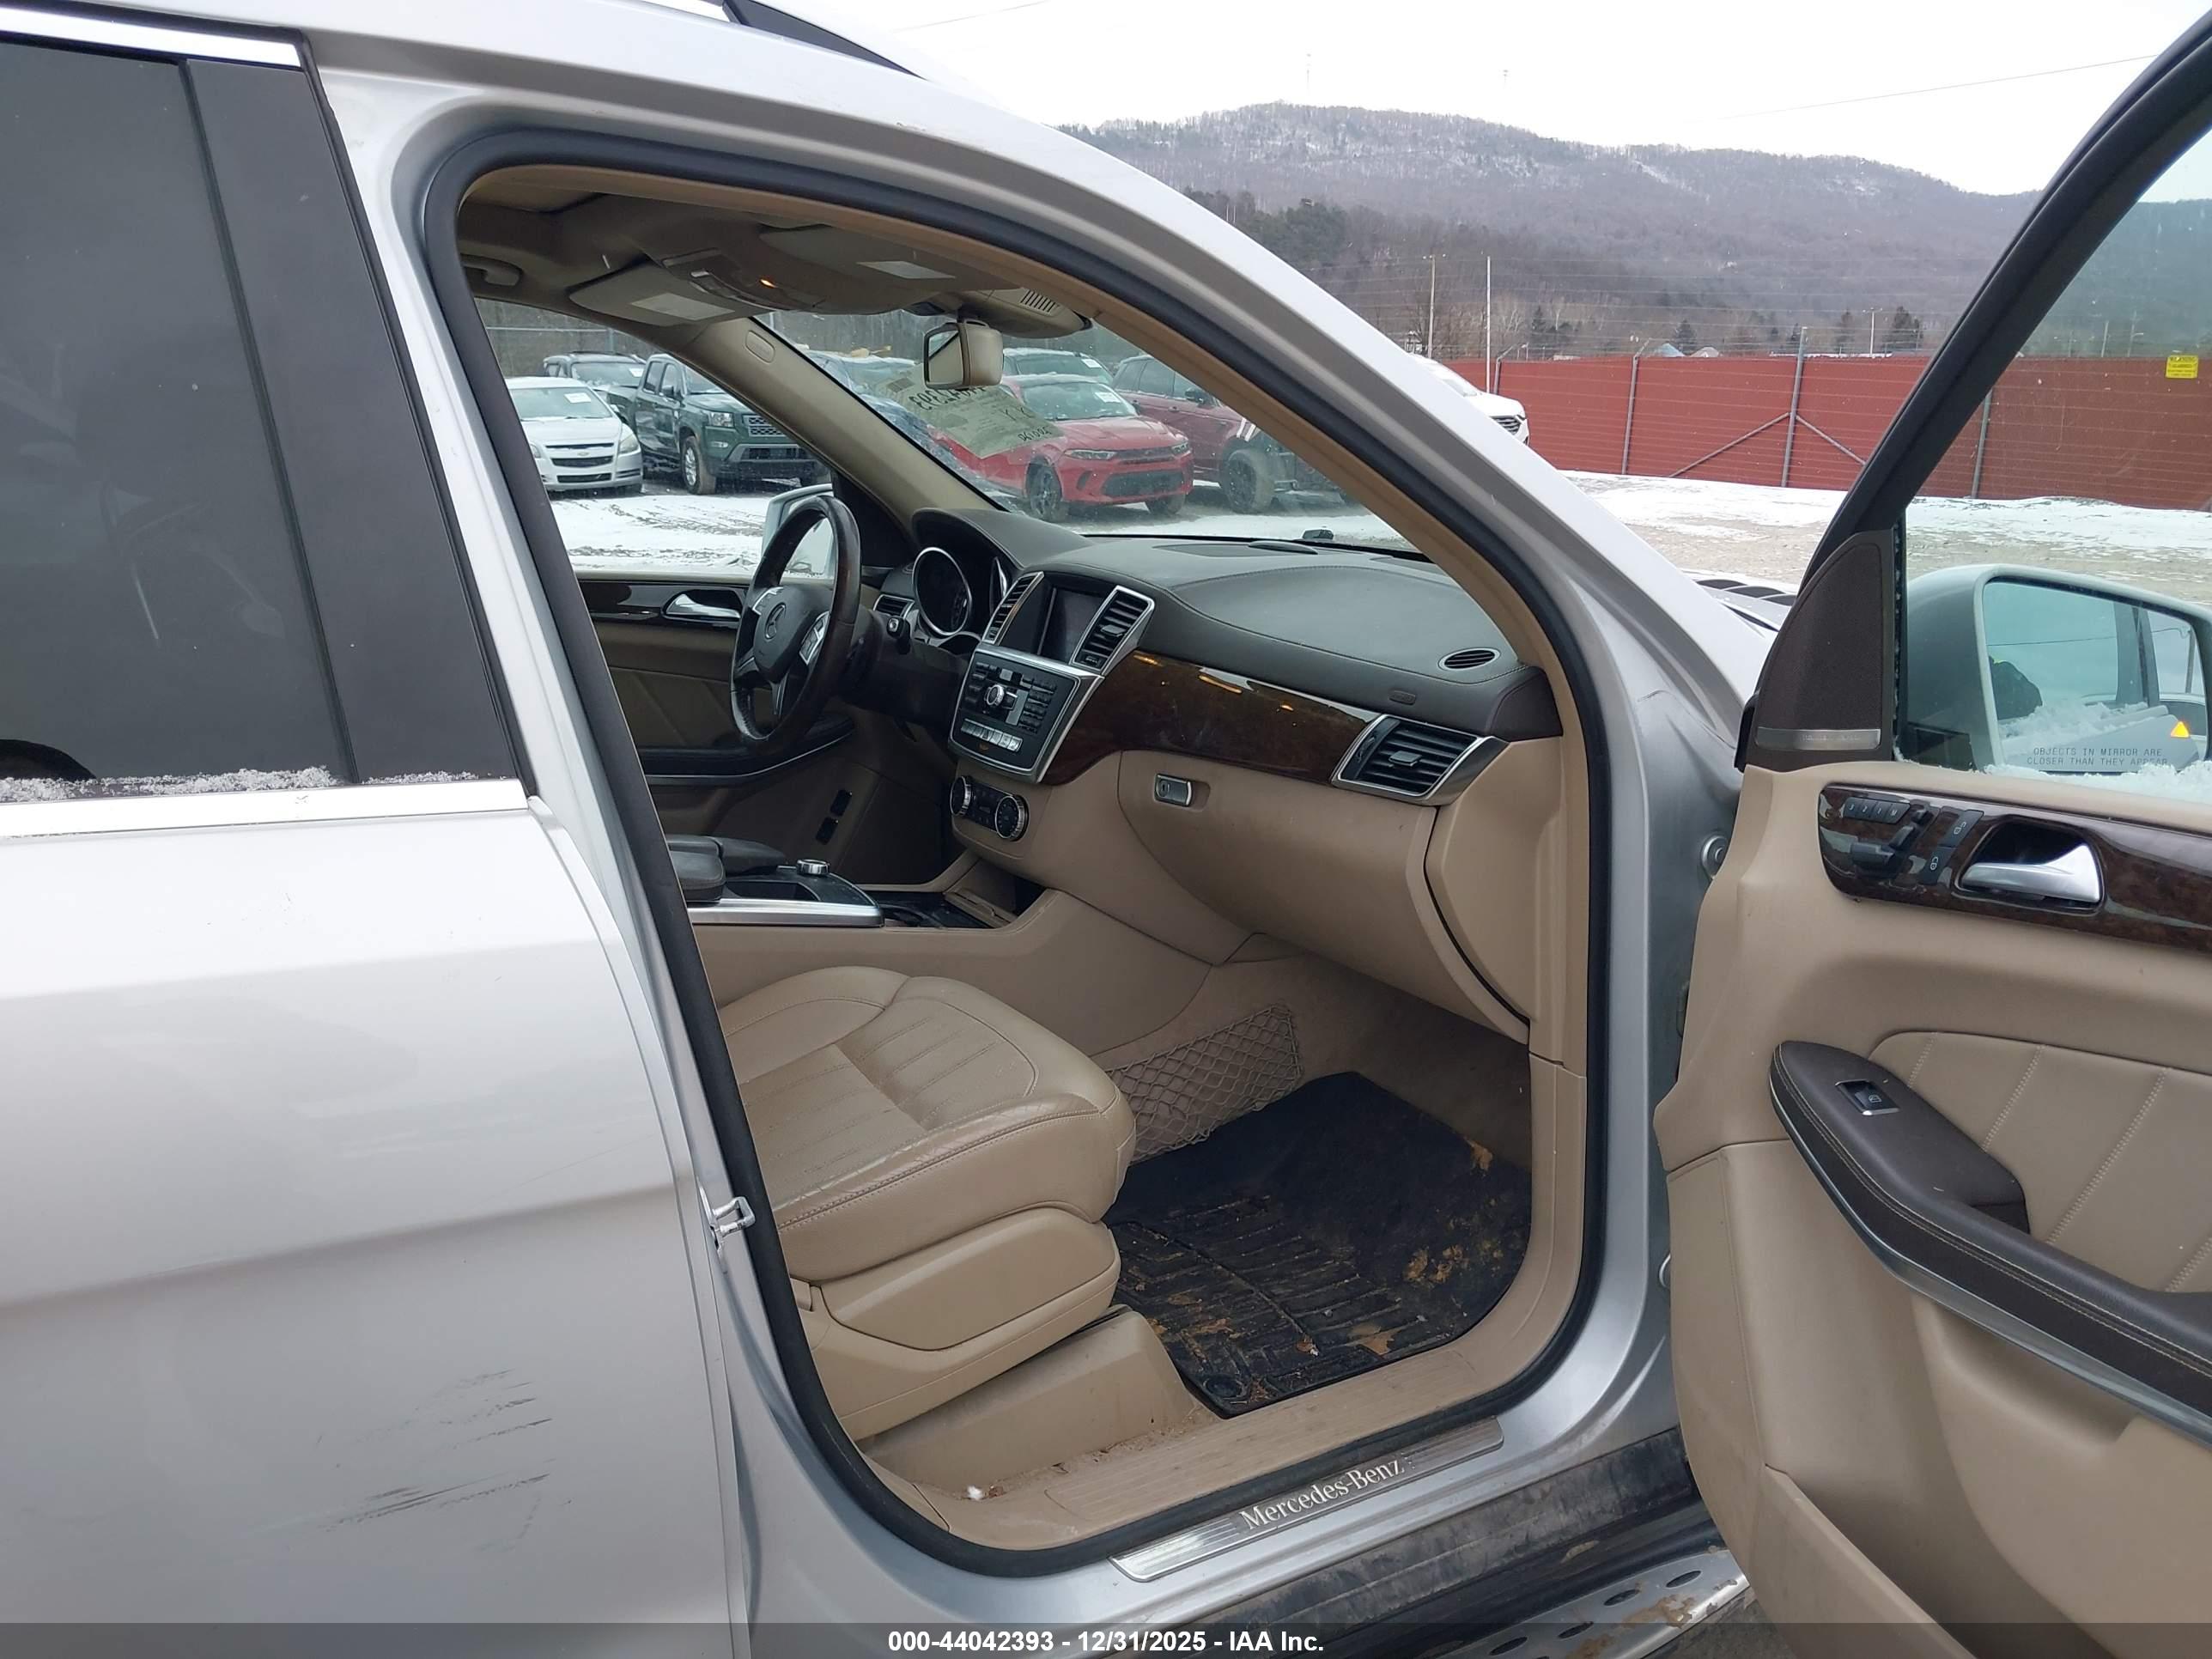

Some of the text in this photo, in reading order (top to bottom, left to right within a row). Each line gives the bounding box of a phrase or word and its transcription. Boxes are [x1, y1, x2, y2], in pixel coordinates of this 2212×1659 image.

[2033, 747, 2076, 756] OBJECTS
[2100, 748, 2138, 757] MIRROR
[2143, 748, 2162, 757] ARE
[2027, 757, 2063, 765] CLOSER
[1239, 1459, 1405, 1529] Mercedes-Benz
